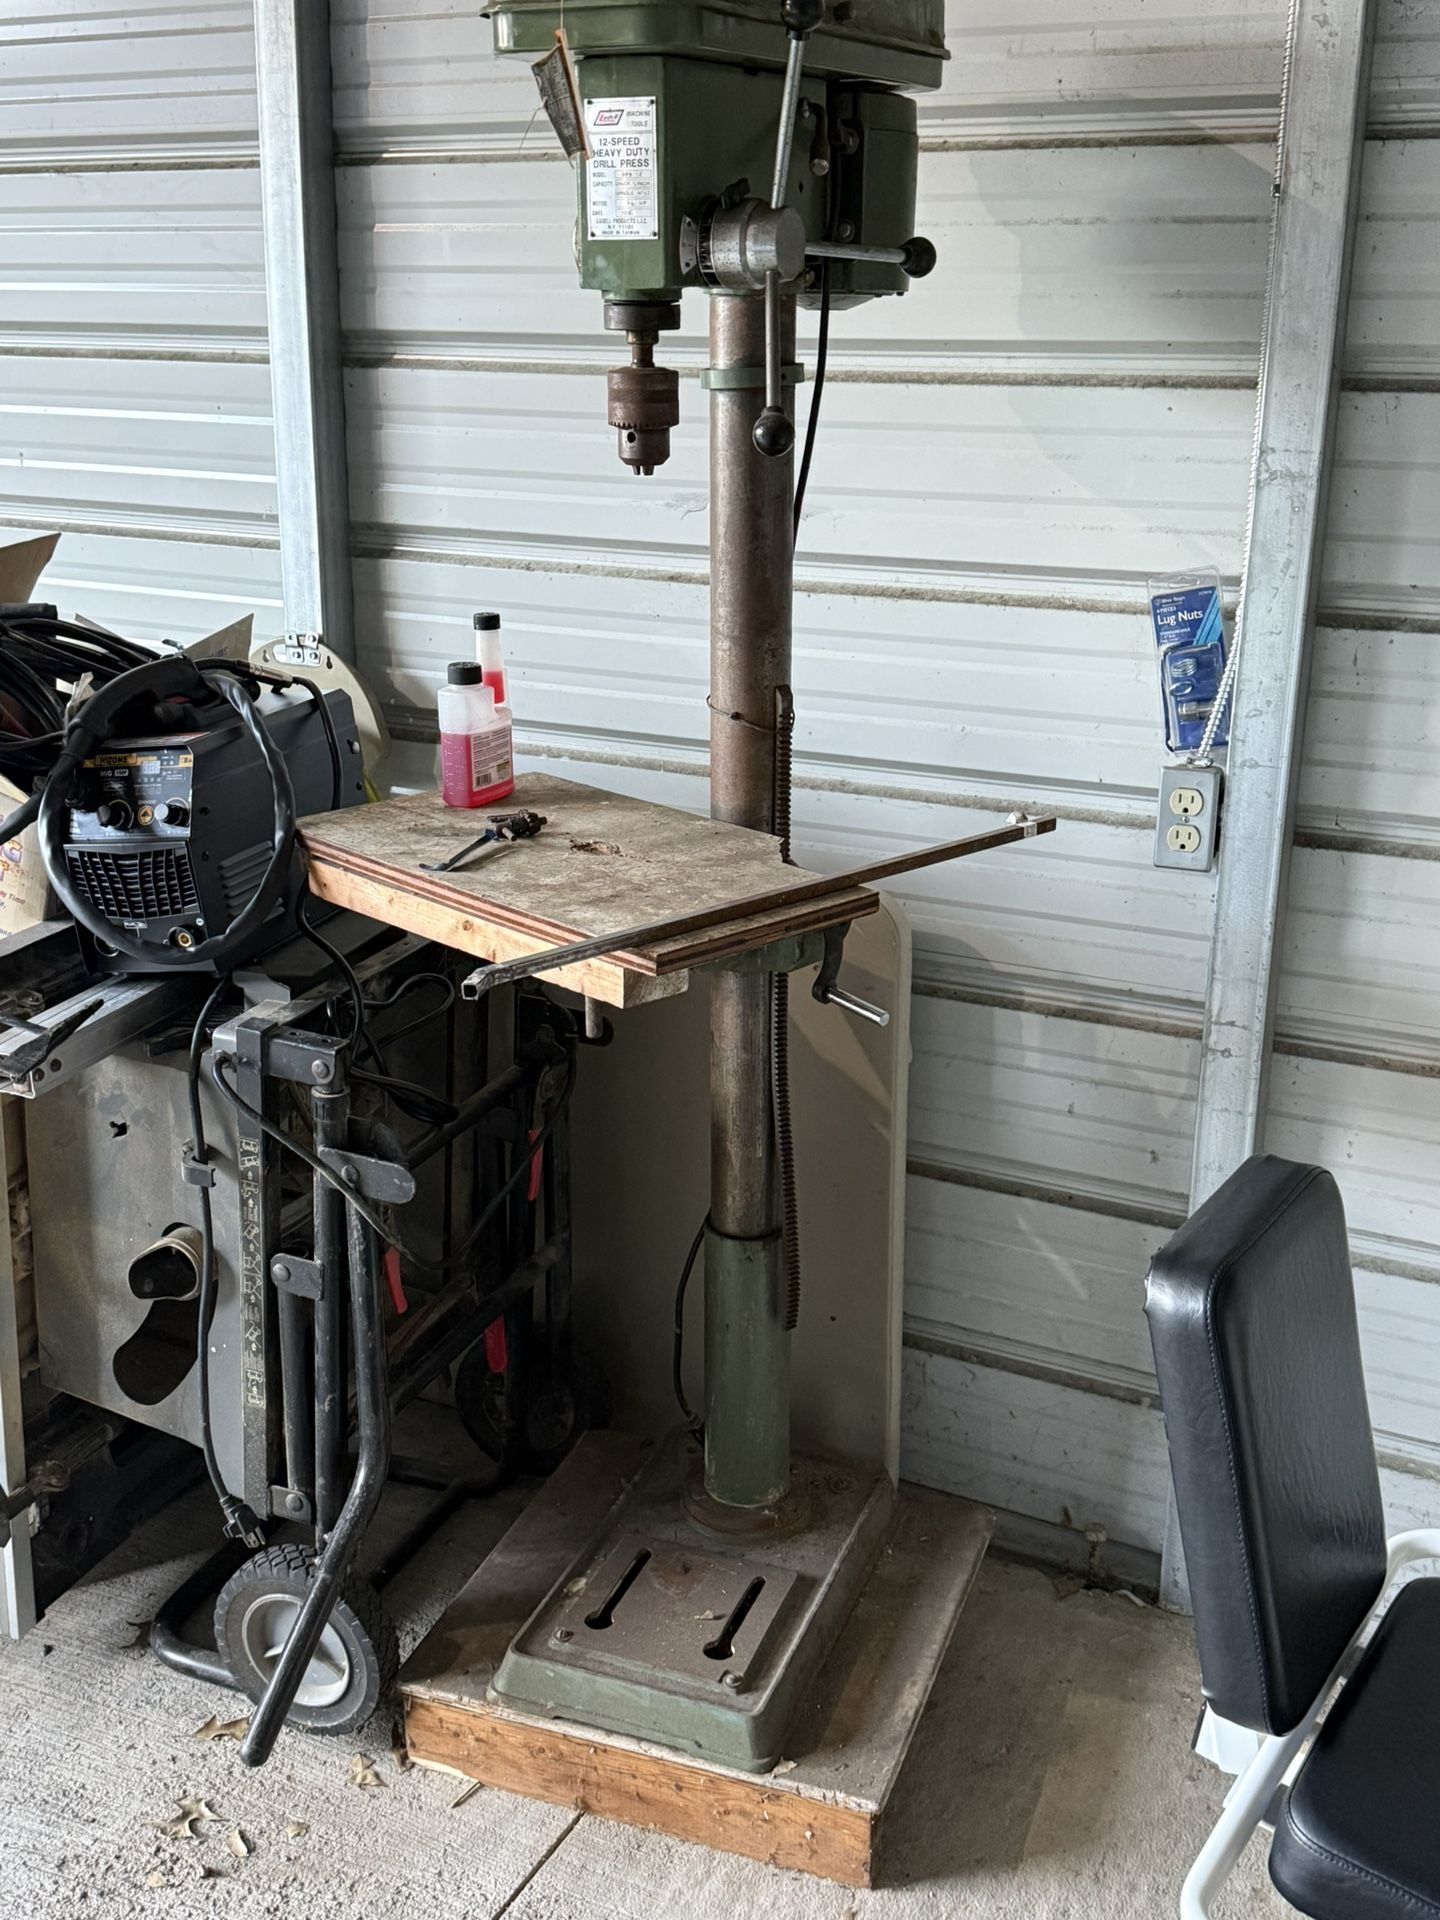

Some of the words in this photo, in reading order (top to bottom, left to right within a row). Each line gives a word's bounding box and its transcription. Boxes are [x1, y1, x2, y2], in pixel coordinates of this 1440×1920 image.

[599, 136, 640, 146] 12-SPEED
[593, 148, 622, 157] HEAVY
[626, 147, 650, 157] DUTY
[593, 159, 616, 168] DRILL
[620, 158, 650, 168] PRESS
[1157, 614, 1177, 626] Lug
[1178, 610, 1204, 622] Nuts
[9, 893, 26, 905] Time
